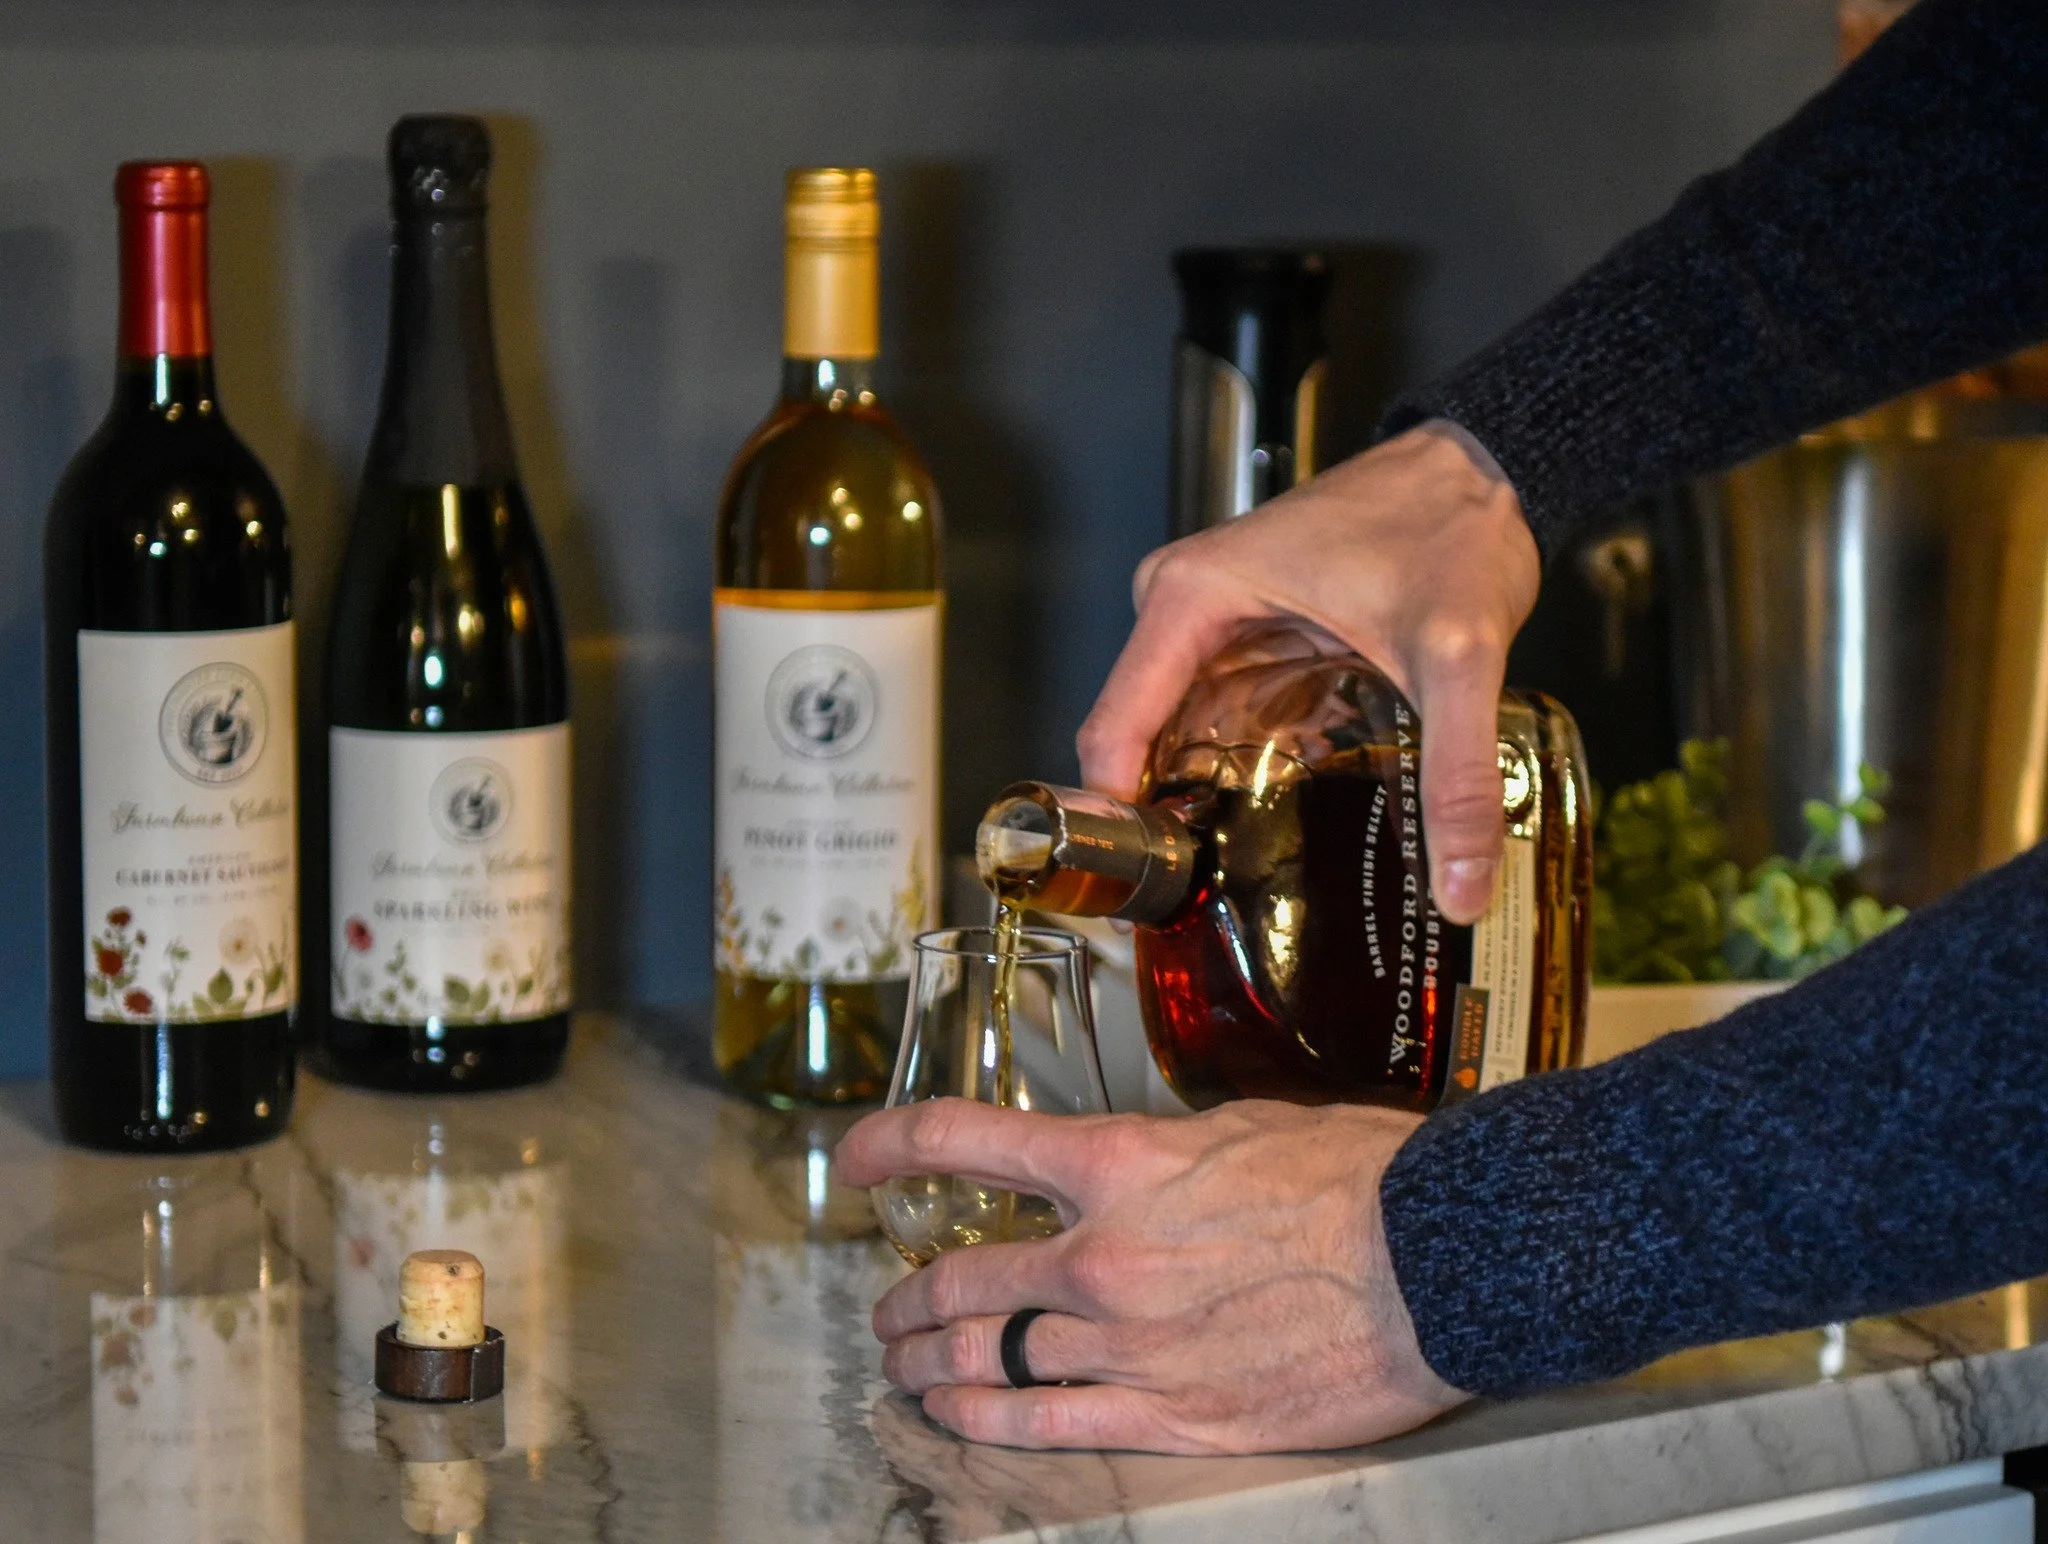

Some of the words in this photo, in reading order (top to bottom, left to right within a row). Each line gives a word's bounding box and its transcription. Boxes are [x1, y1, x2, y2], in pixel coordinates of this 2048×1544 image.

[1366, 784, 1389, 844] SELECT
[1396, 707, 1418, 860] RESERVE
[1362, 848, 1376, 907] FINISH
[1365, 912, 1387, 979] BARREL
[1389, 873, 1418, 1064] WOODFORD
